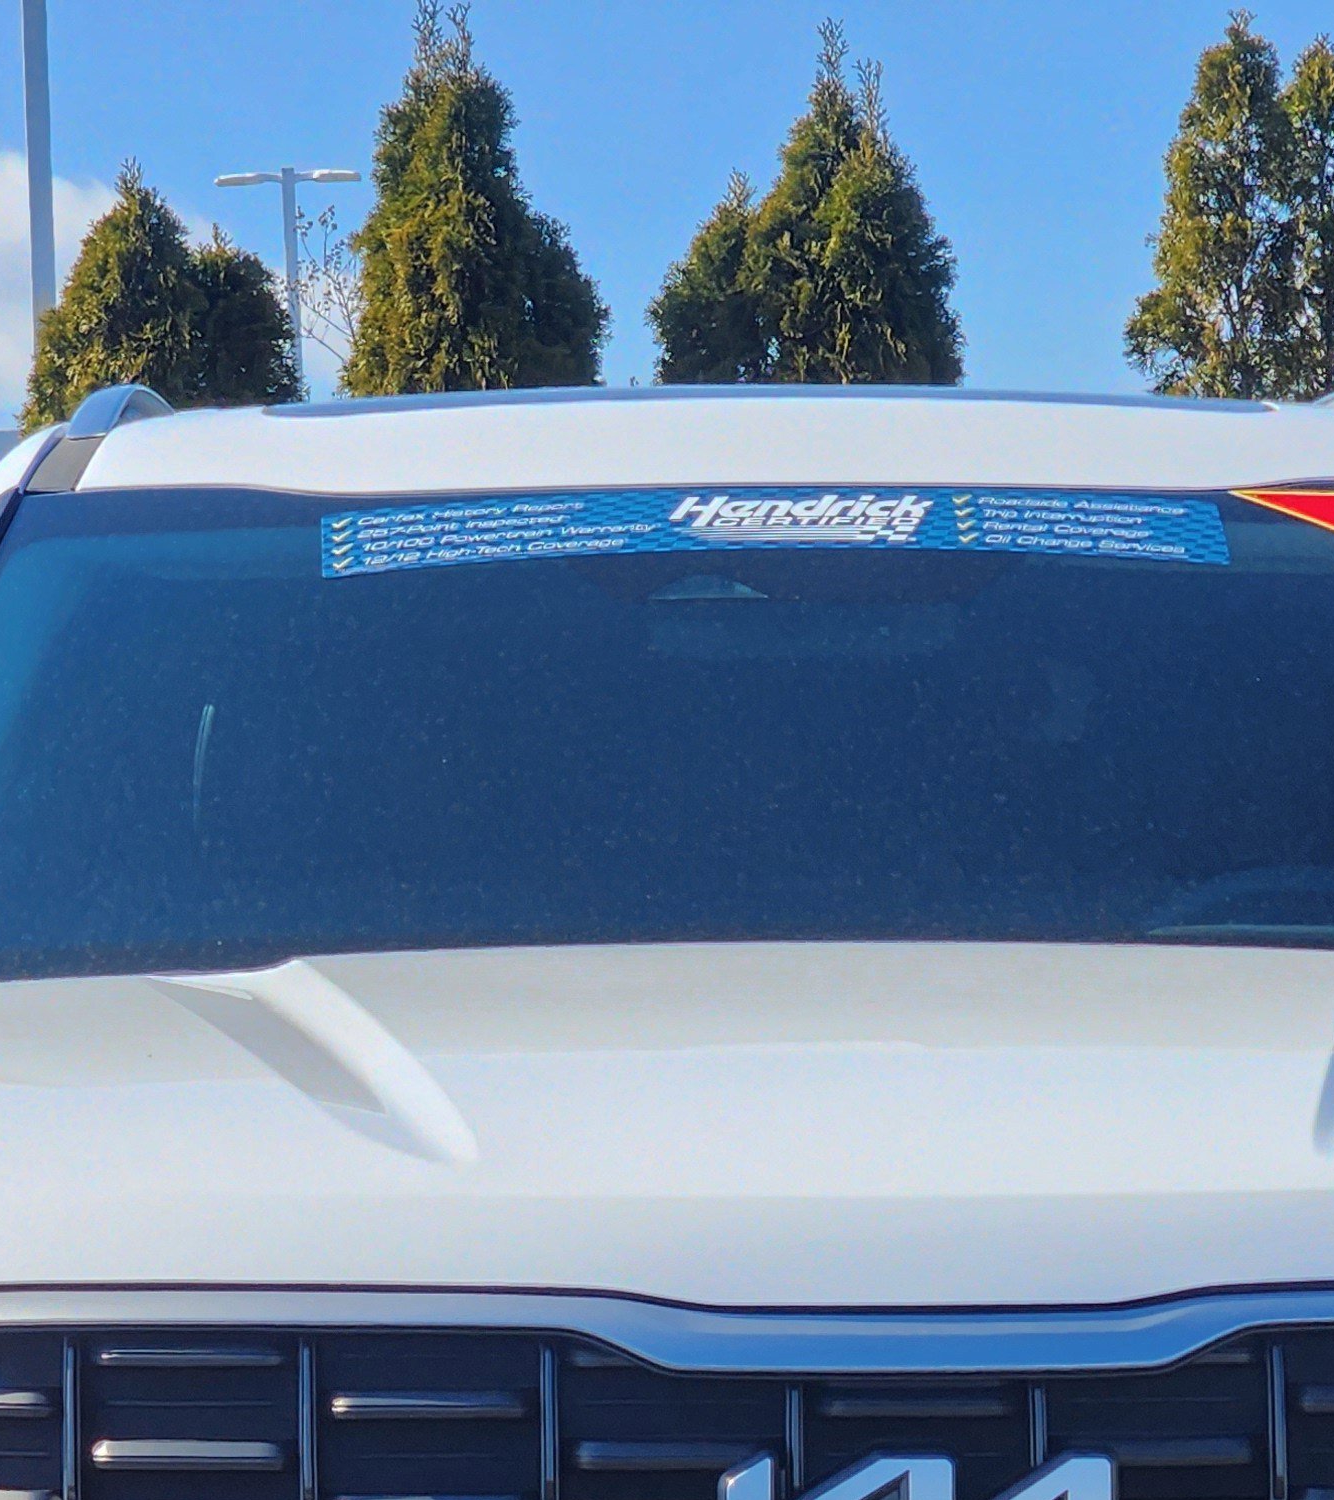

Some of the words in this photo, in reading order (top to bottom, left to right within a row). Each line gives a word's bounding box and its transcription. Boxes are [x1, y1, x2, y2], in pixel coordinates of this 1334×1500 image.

[357, 513, 425, 526] Carfax
[433, 507, 508, 520] History
[513, 502, 585, 514] Report
[669, 494, 935, 527] Hendrick
[977, 496, 1068, 508] Roadside
[1073, 499, 1186, 514] Assistance
[712, 516, 922, 527] CERTIFIED
[982, 508, 1018, 520] Trip
[1023, 510, 1143, 525] Interruption
[363, 537, 435, 552] 10/100
[440, 528, 553, 546] Powertrain
[982, 521, 1048, 533] Rental
[1053, 524, 1150, 538] Coverage
[364, 551, 422, 566] 12/12
[426, 541, 522, 560] High-Tech
[985, 533, 1012, 545] Oil
[1017, 536, 1093, 549] Change
[1098, 540, 1186, 554] Services
